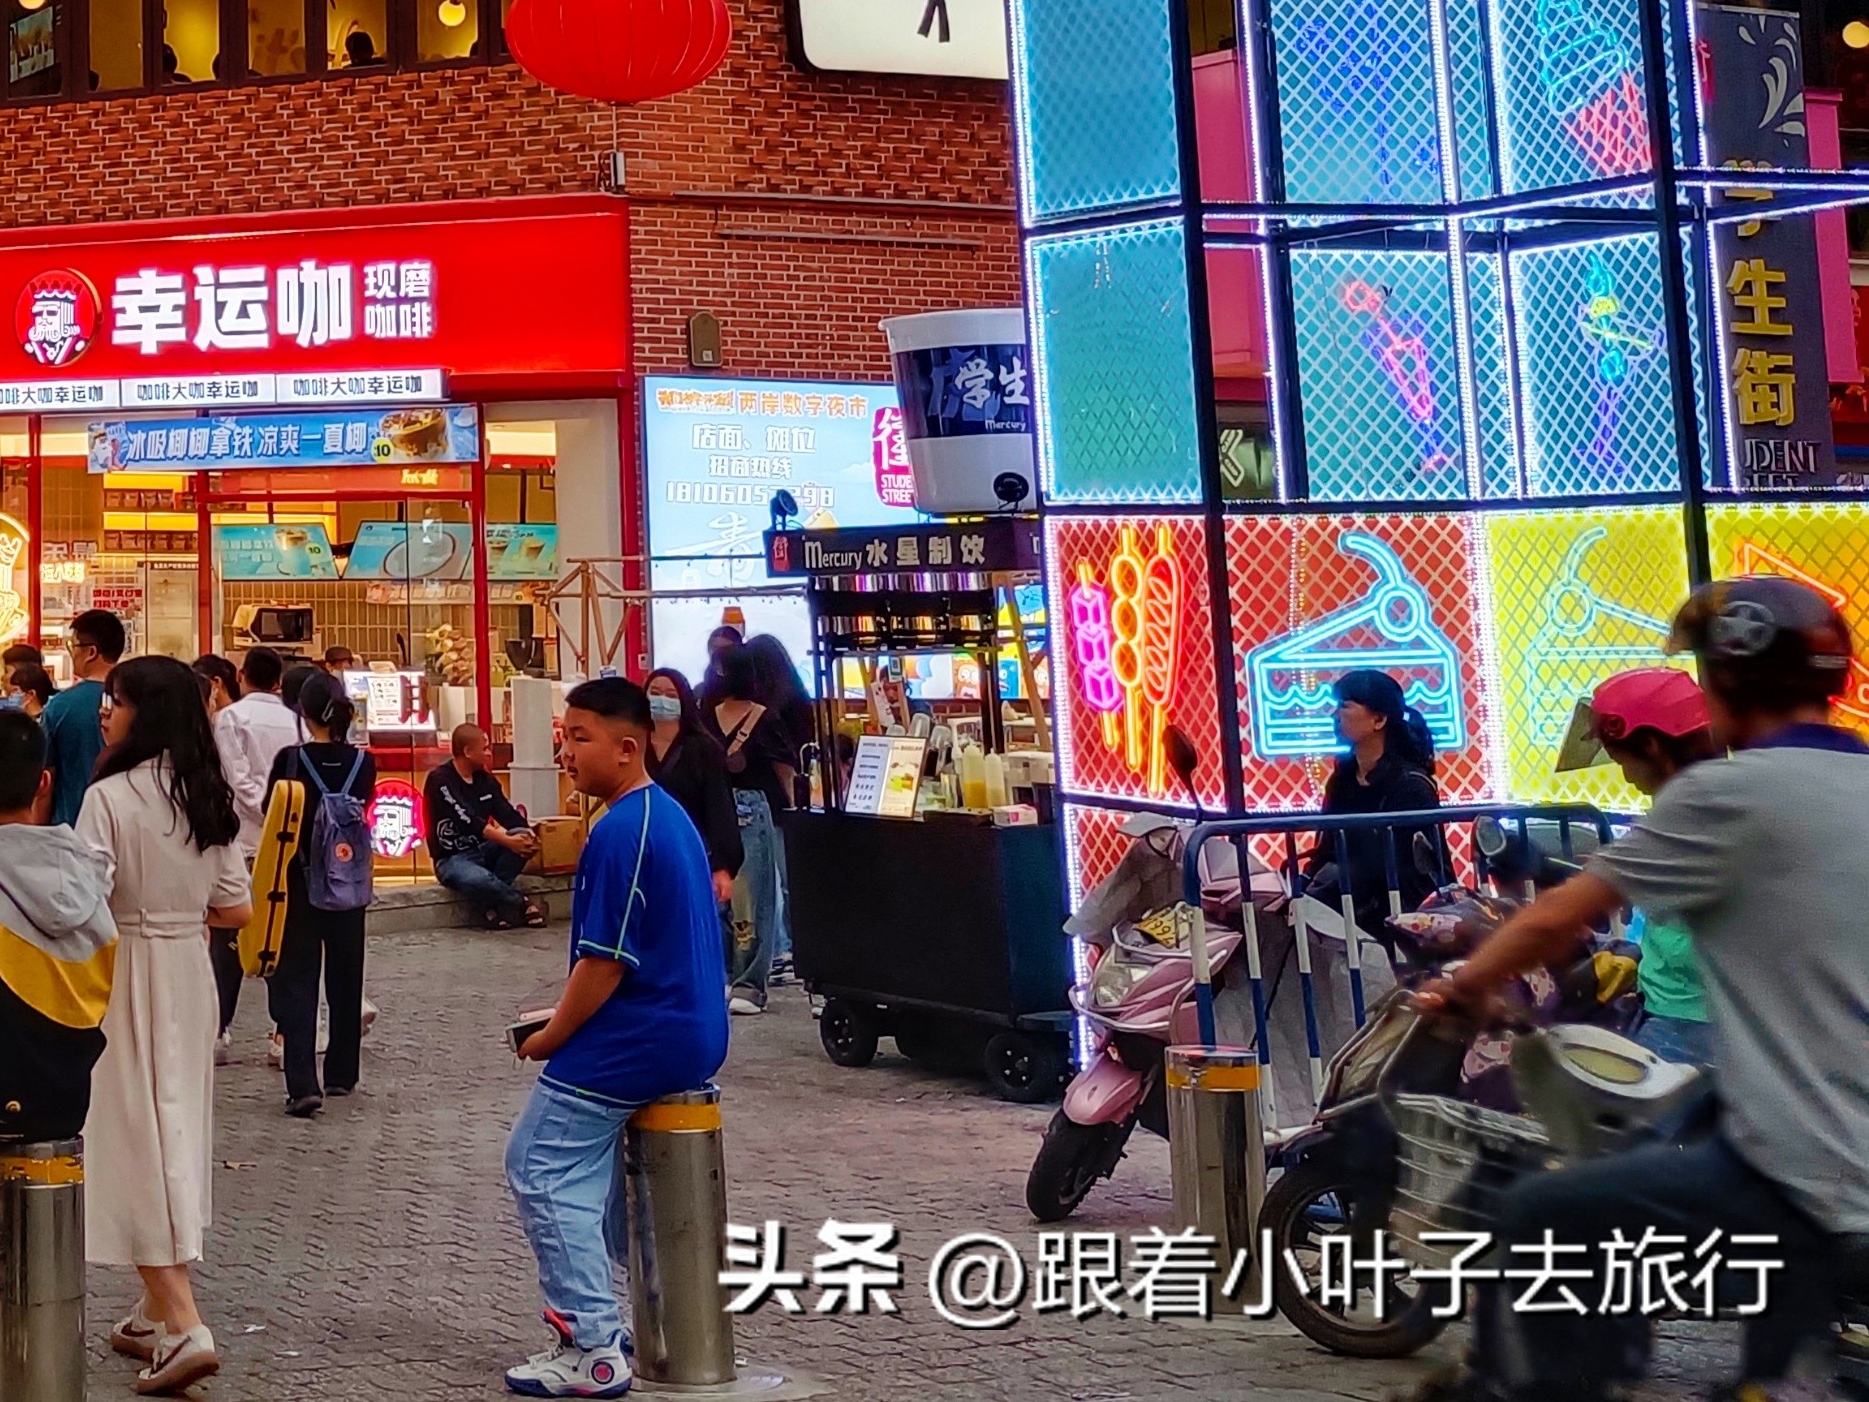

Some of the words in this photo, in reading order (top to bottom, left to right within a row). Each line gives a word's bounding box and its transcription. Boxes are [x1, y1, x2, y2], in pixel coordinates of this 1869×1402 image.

[111, 260, 352, 354] 幸运咖
[364, 262, 431, 299] 现磨
[364, 304, 432, 338] 咖啡
[136, 380, 258, 400] 咖啡大咖幸运咖
[293, 375, 423, 396] 咖啡大咖幸运咖
[738, 391, 868, 417] 两岸数字夜市
[708, 455, 793, 479] 招商热线
[1743, 439, 1823, 475] DENT
[666, 481, 835, 508] 181060598
[880, 475, 913, 489] STUDE
[881, 488, 913, 504] STREE
[866, 534, 986, 567] 水星制饮
